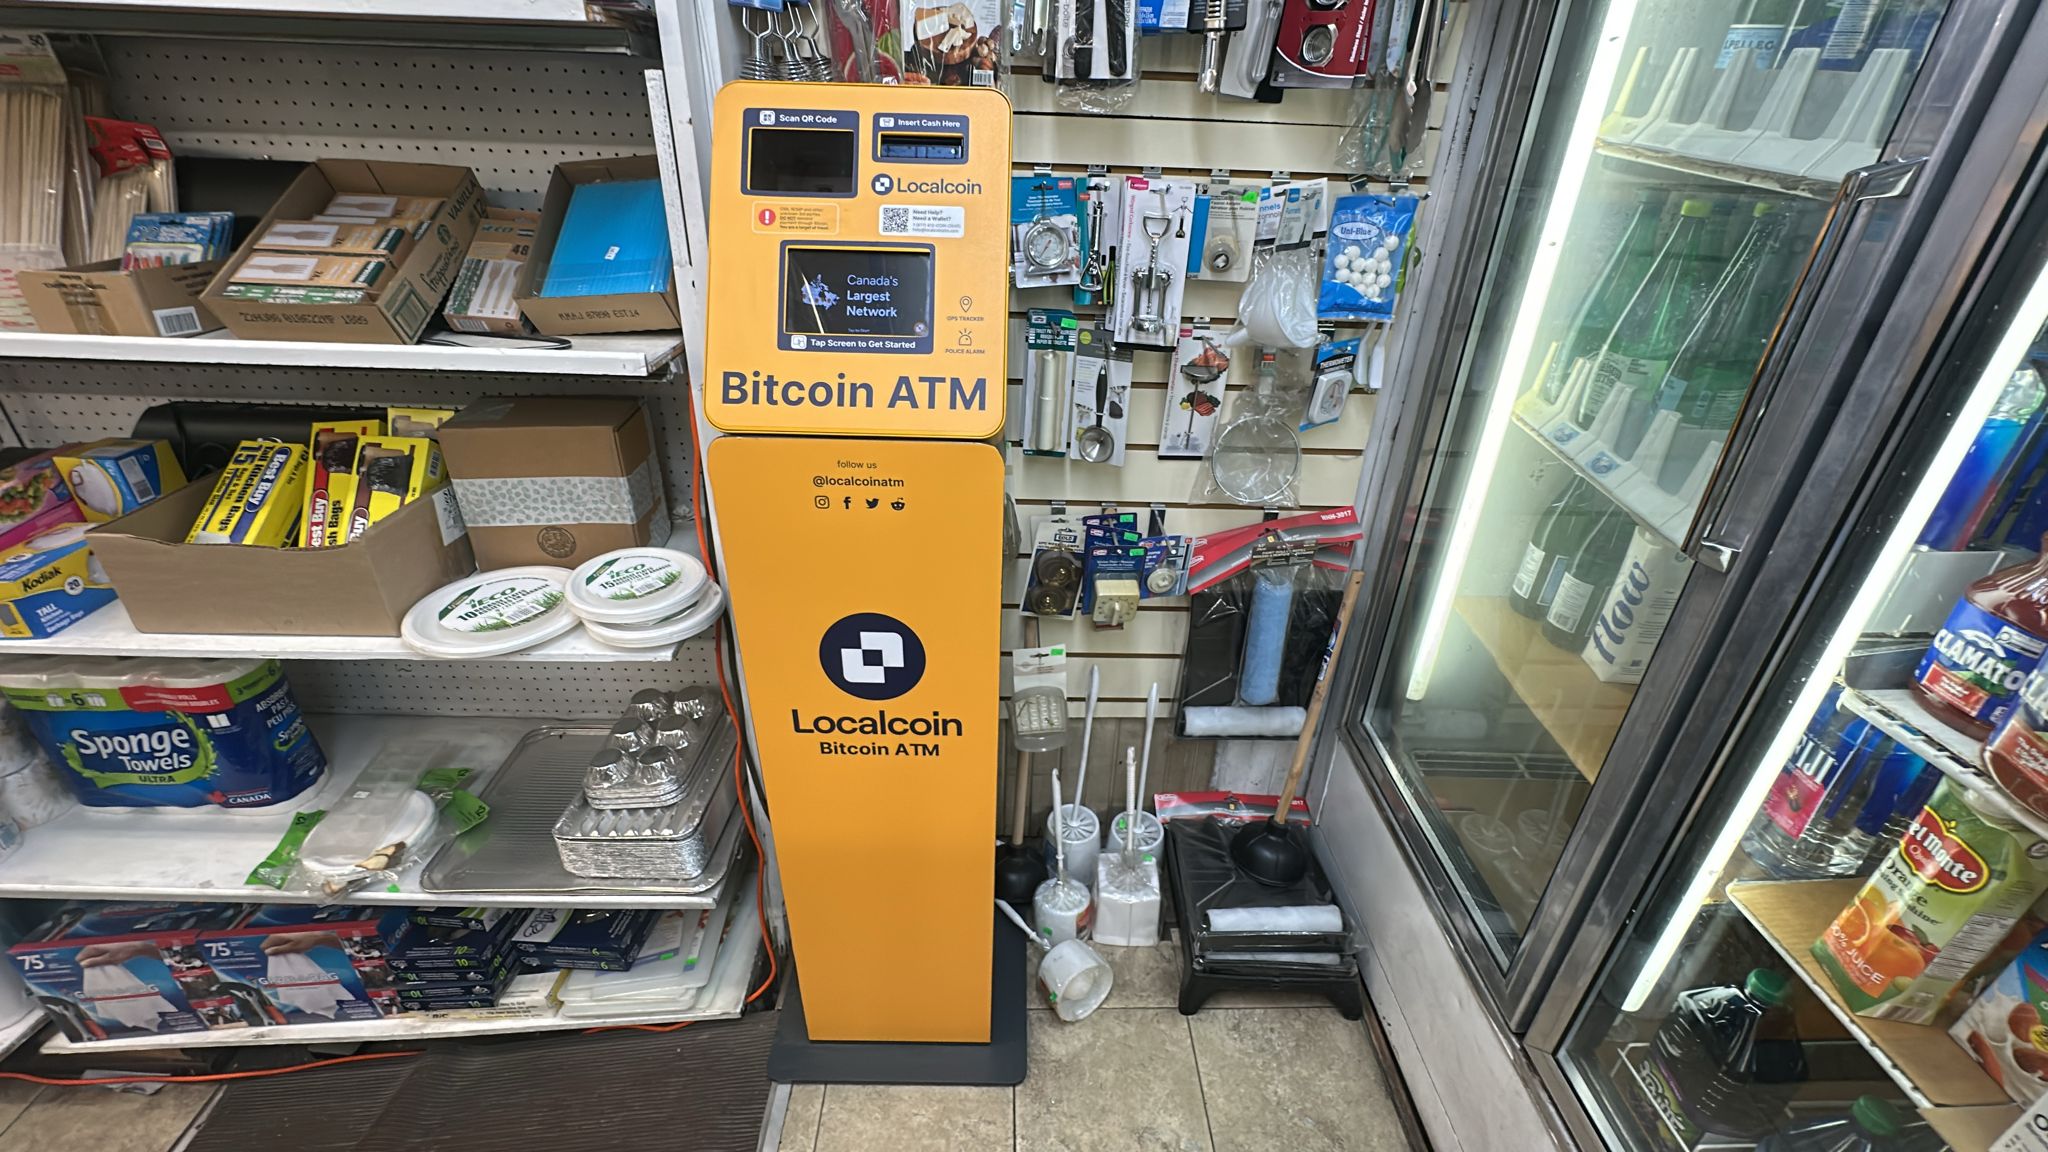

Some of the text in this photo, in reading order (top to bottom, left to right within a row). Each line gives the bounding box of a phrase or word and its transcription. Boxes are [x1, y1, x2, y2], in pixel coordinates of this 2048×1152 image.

[780, 114, 838, 124] Scan QR Code
[898, 119, 961, 128] Insert Cash Here
[897, 178, 982, 195] Localcoin
[1260, 204, 1280, 212] nnels
[1340, 226, 1372, 236] Uni-Blue
[512, 244, 530, 256] 48
[847, 274, 899, 287] Canada's
[847, 290, 890, 304] Largest
[846, 306, 898, 318] Network
[811, 339, 826, 349] Tap
[828, 340, 856, 348] Screen
[858, 340, 867, 348] to
[869, 340, 883, 348] Get
[722, 370, 987, 411] Bitcoin ATM
[233, 445, 263, 465] 15
[837, 460, 864, 469] follow
[248, 454, 288, 505] Best Buy
[812, 475, 904, 488] @localcoinatm
[218, 445, 274, 532] Tall Kitchen Bags
[328, 500, 342, 529] Bags
[309, 497, 328, 548] est Buy
[616, 563, 646, 578] ECO
[22, 566, 63, 593] Kodiak
[67, 579, 82, 589] 20
[600, 580, 616, 589] 15
[476, 586, 516, 606] ECO
[36, 603, 58, 617] TALL
[456, 611, 478, 620] 10
[1592, 560, 1650, 665] flow
[1933, 628, 2026, 691] CLAMATO
[2019, 669, 2048, 718] CLA
[267, 711, 284, 728] PEU
[792, 708, 962, 736] Localcoin
[70, 728, 190, 759] Sponge
[820, 741, 940, 756] Bitcoin ATM
[119, 753, 192, 773] Towels
[1795, 734, 1837, 784] IJI
[138, 774, 176, 784] ULTRA
[228, 792, 272, 805] CANADA
[1922, 832, 1978, 884] Monte
[204, 942, 231, 957] 75
[16, 954, 45, 970] 75
[1846, 948, 1886, 984] JUICE
